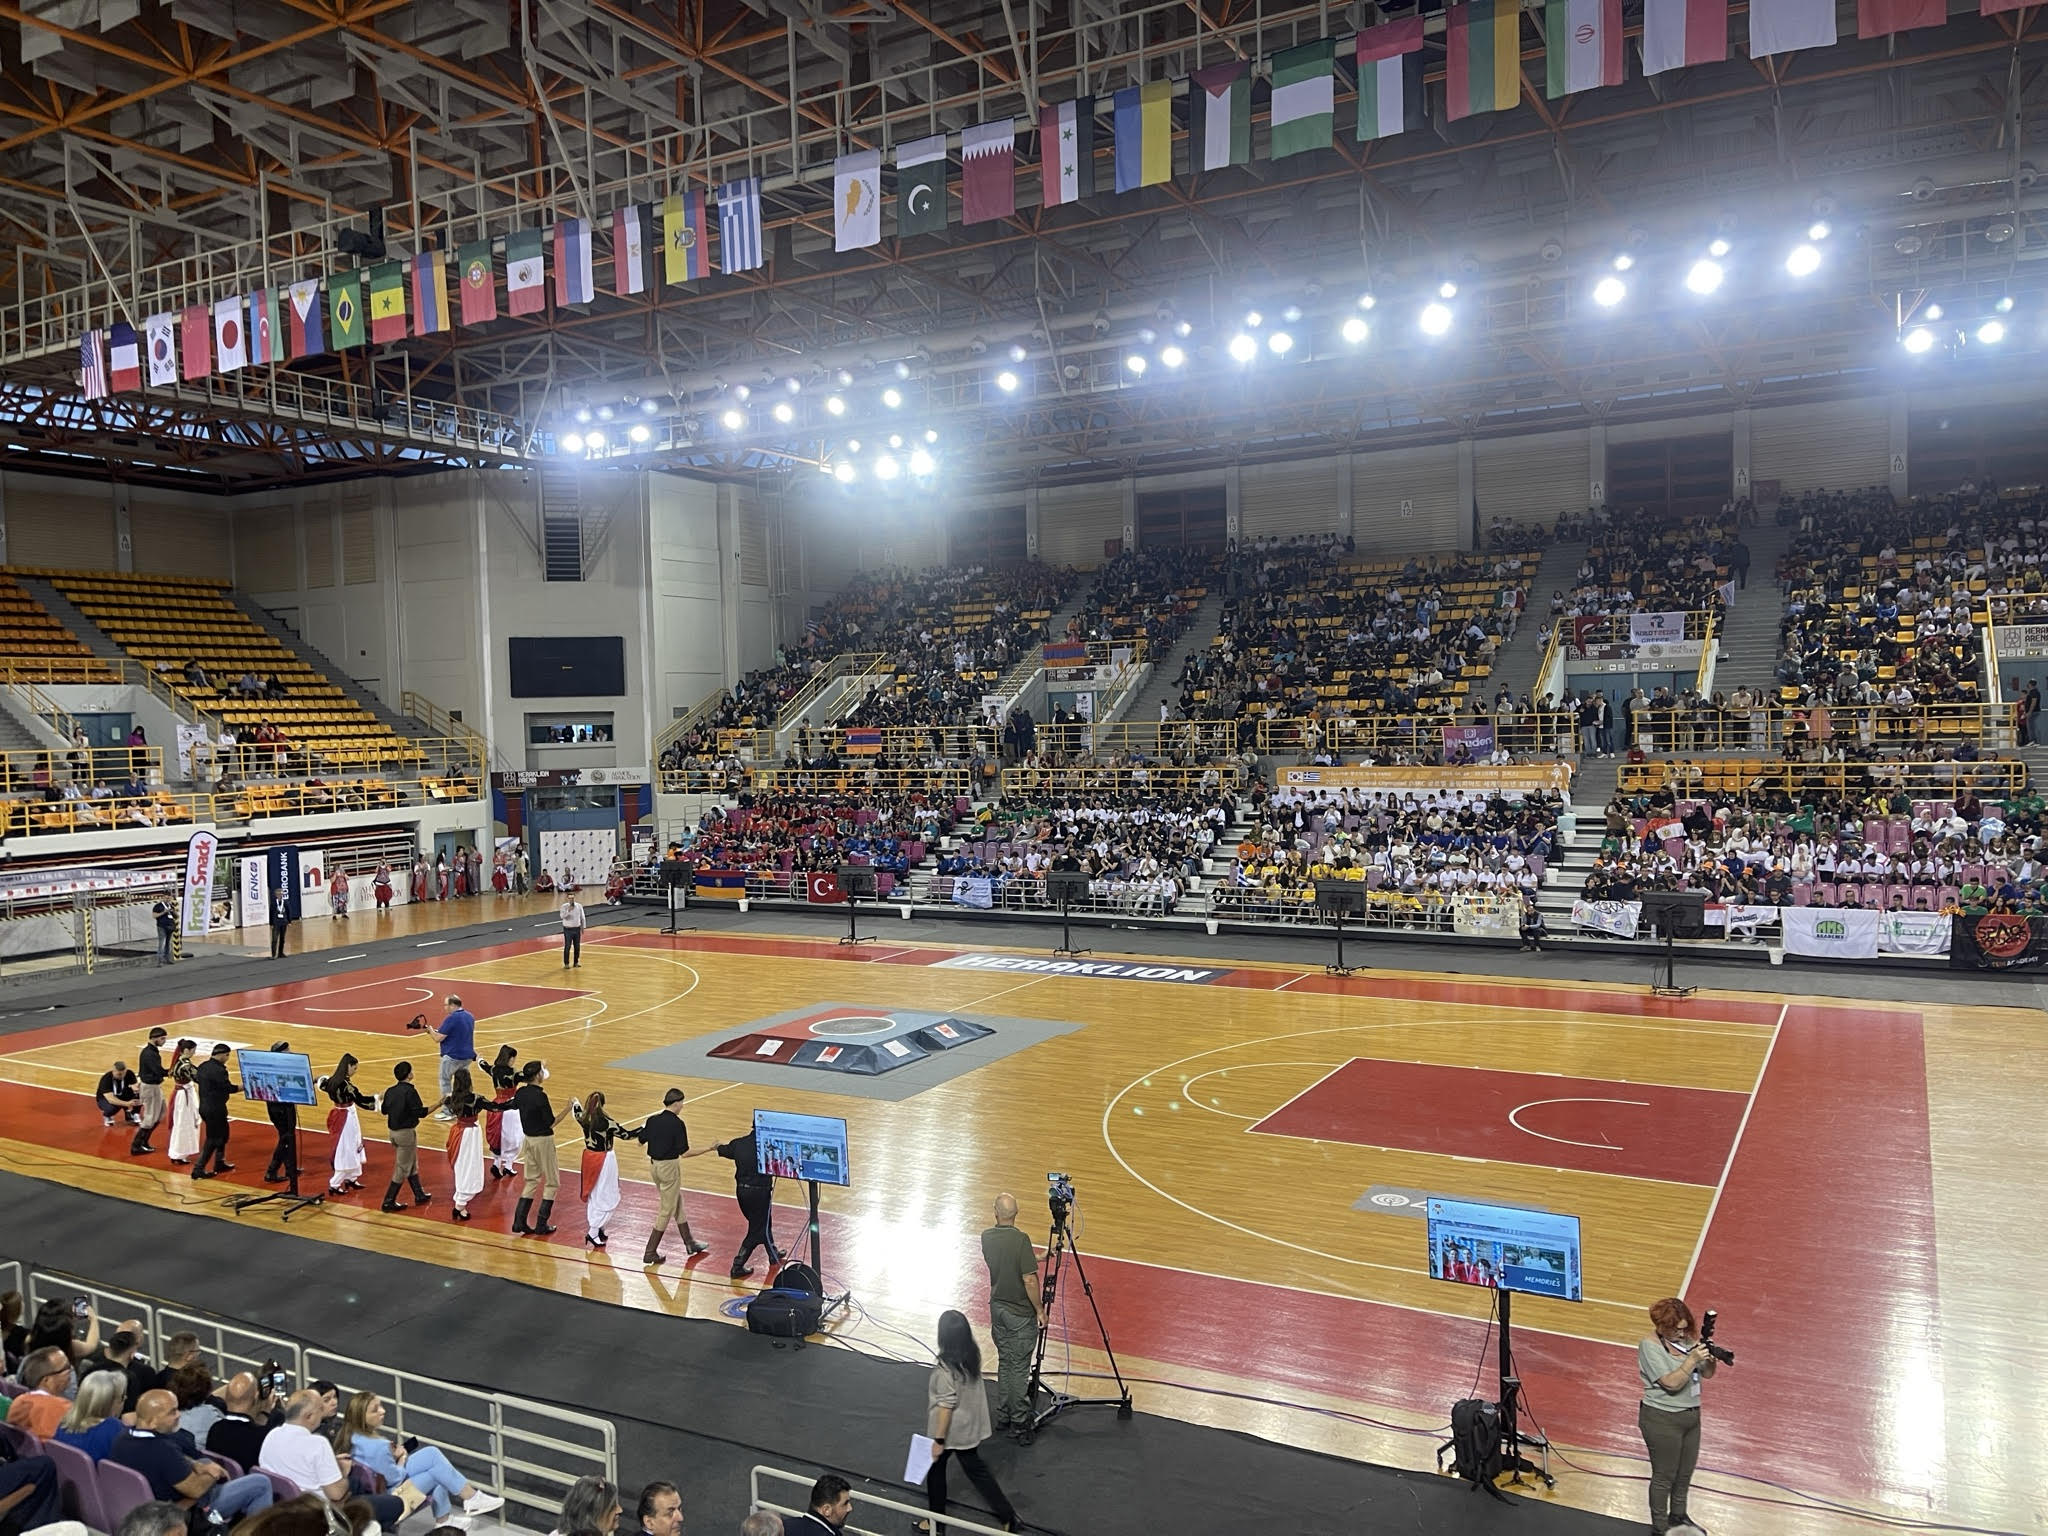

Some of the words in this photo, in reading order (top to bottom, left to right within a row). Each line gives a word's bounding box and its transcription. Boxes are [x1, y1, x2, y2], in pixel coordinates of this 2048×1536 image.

[280, 852, 290, 900] EUROBANK
[953, 956, 1213, 981] HERAKLION
[1524, 1275, 1561, 1288] MEMORIES
